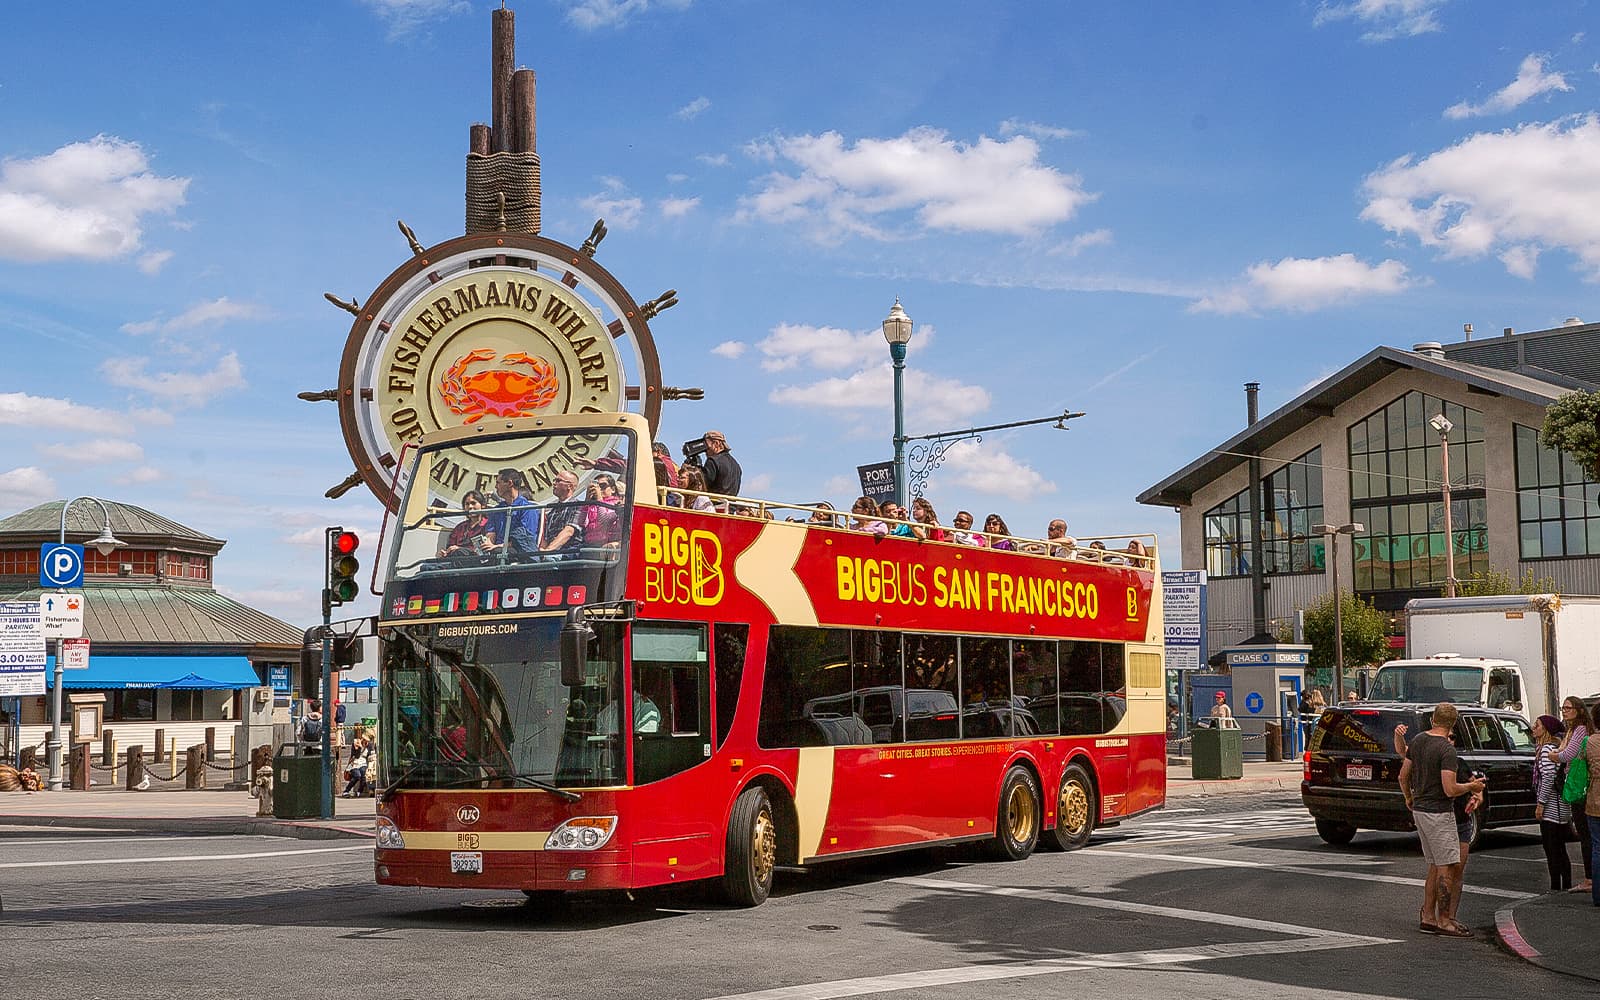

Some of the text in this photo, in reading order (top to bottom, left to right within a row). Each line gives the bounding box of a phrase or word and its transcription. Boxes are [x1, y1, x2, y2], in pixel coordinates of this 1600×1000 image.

[388, 281, 610, 394] FISHERMANS WHARF
[429, 449, 470, 491] AN
[865, 469, 889, 481] PORT
[865, 484, 895, 495] 150 YEARS
[644, 522, 689, 566] BIG
[54, 553, 73, 578] P
[645, 566, 691, 605] BUS
[933, 566, 980, 611] SAN
[987, 571, 1099, 620] FRANCISCO
[438, 624, 518, 637] BIGBUSTOURS.COM
[1164, 626, 1182, 636] .00
[1232, 654, 1261, 663] CHASE
[1280, 654, 1300, 662] CHASE
[878, 750, 895, 760] GREAT
[914, 748, 931, 758] GREAT
[457, 833, 470, 842] BIG
